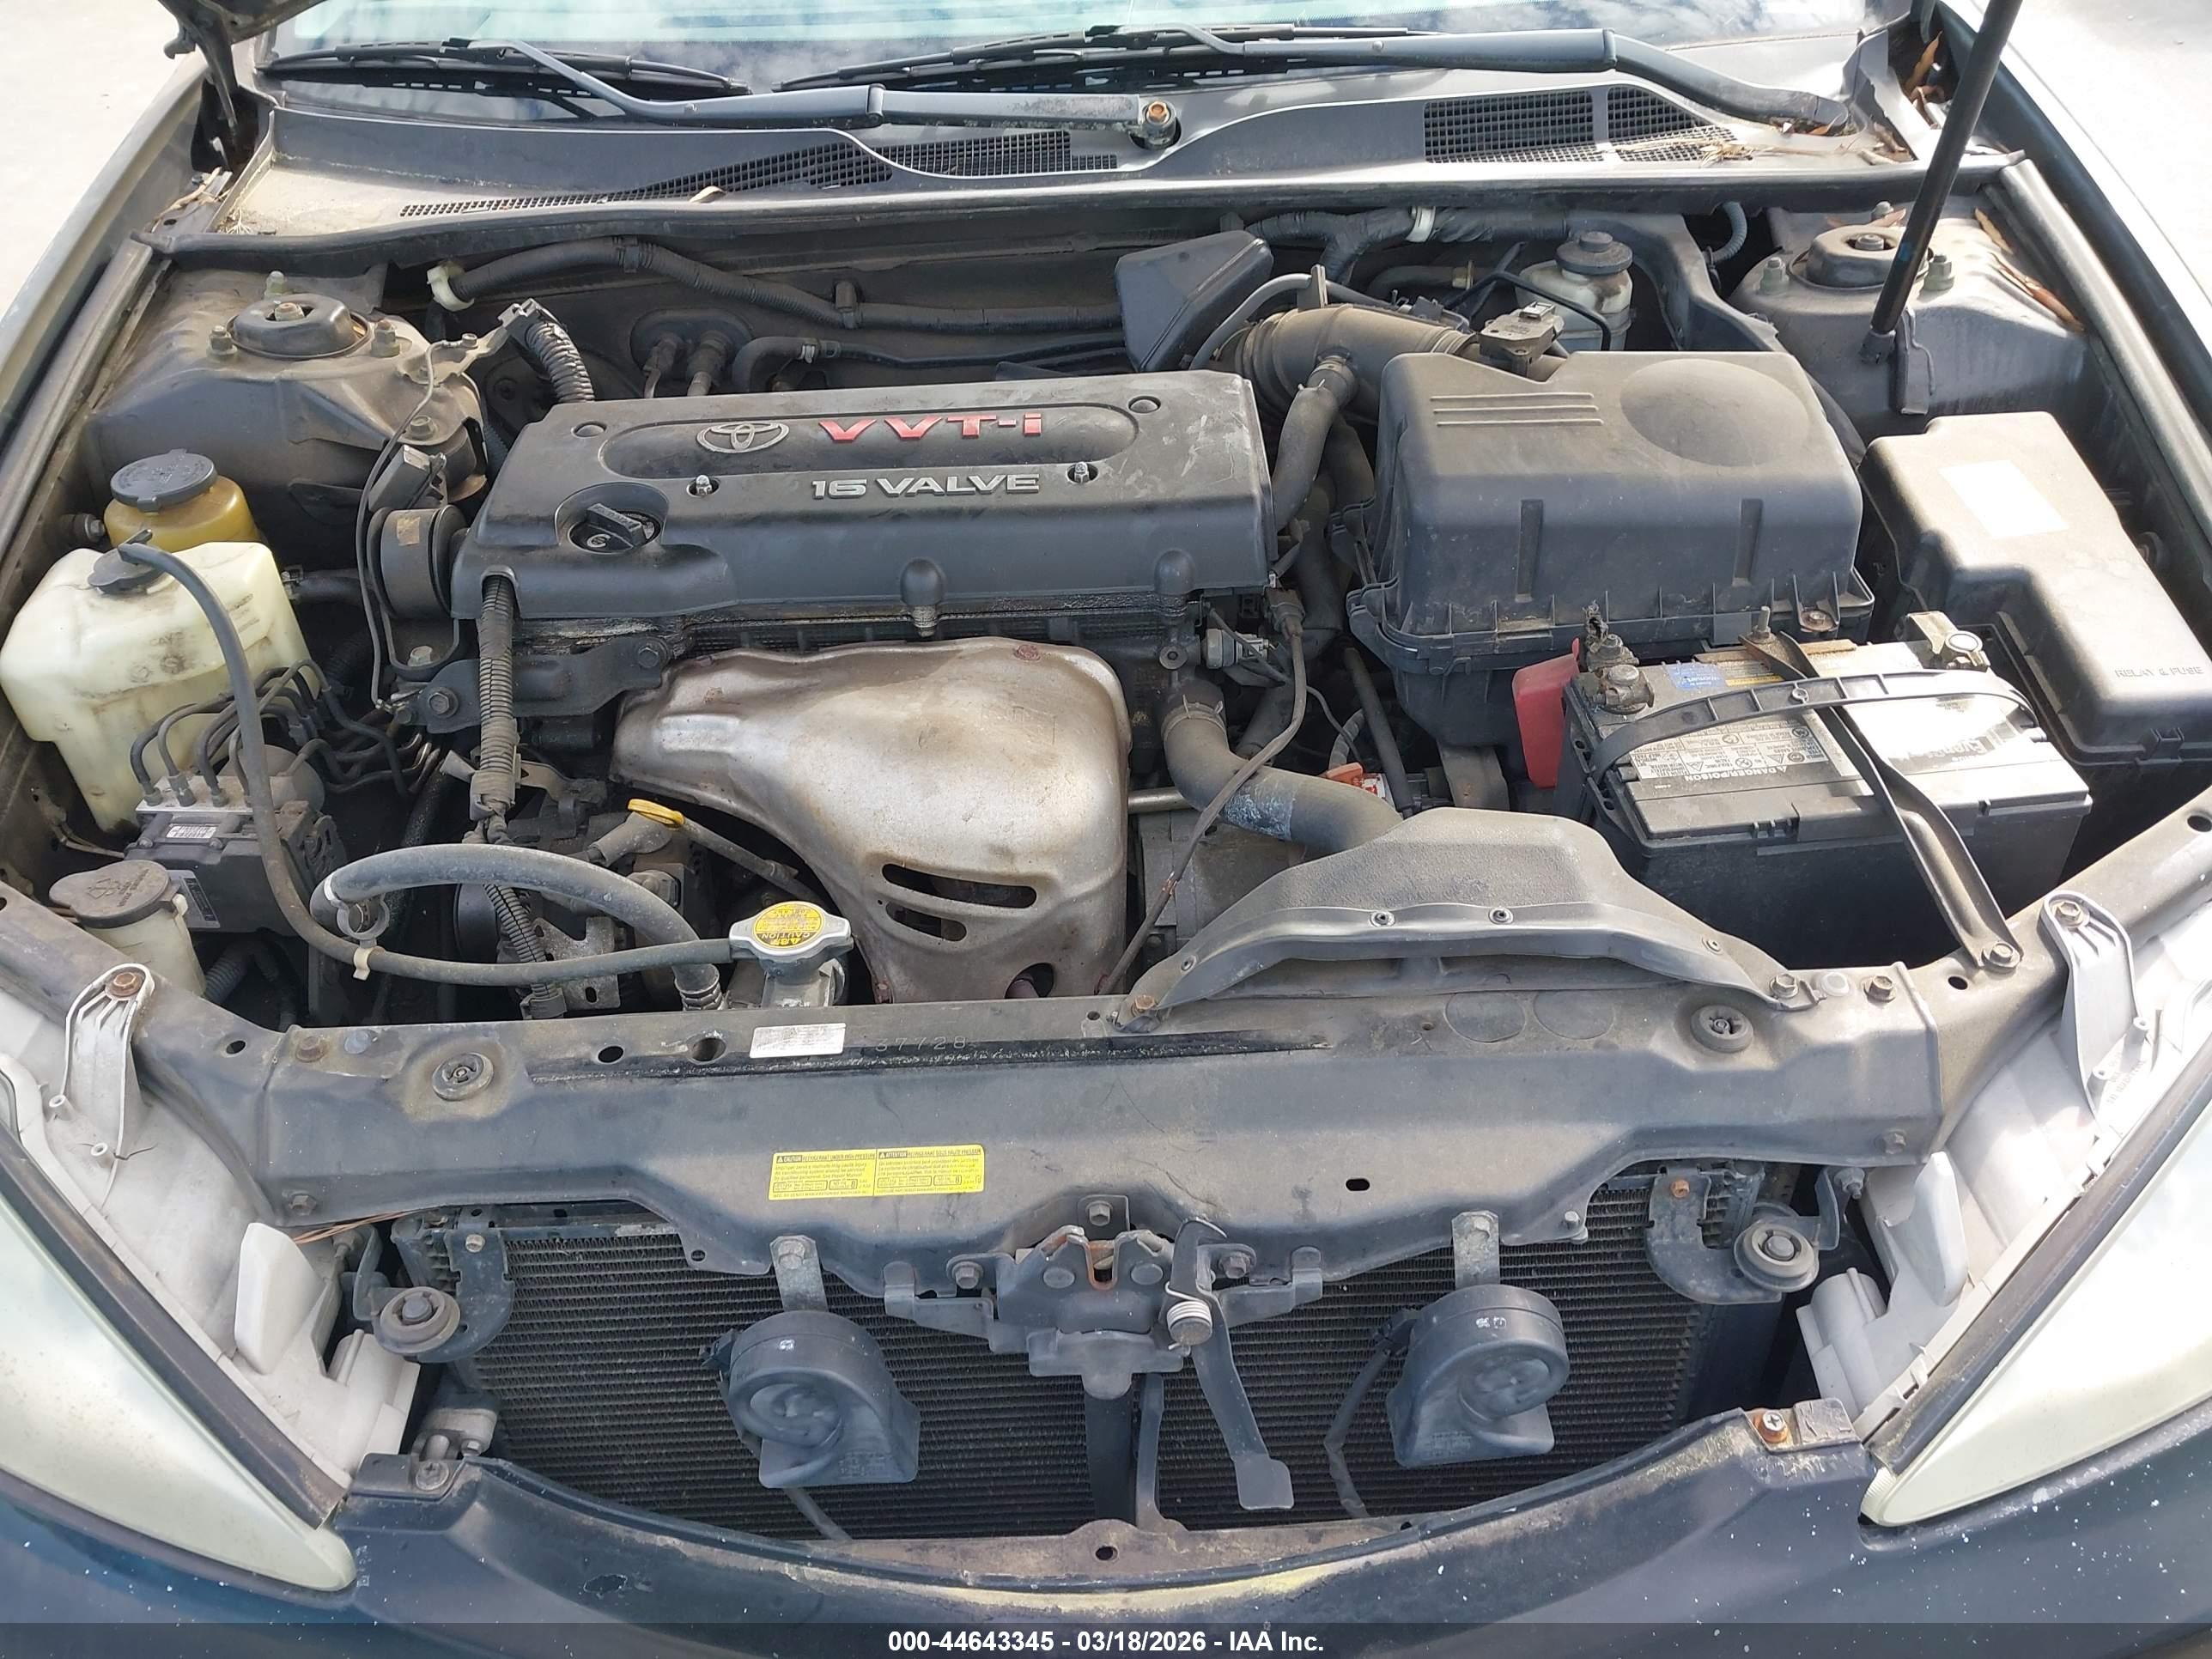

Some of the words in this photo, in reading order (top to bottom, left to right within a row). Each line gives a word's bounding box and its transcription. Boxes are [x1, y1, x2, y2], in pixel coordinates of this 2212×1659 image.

[818, 413, 1042, 443] VVT-i
[811, 478, 867, 499] 16
[875, 473, 1040, 497] VALVE
[2114, 669, 2154, 678] RELAY
[2169, 666, 2204, 675] FUSE
[1684, 766, 1778, 781] DANGER/POISON
